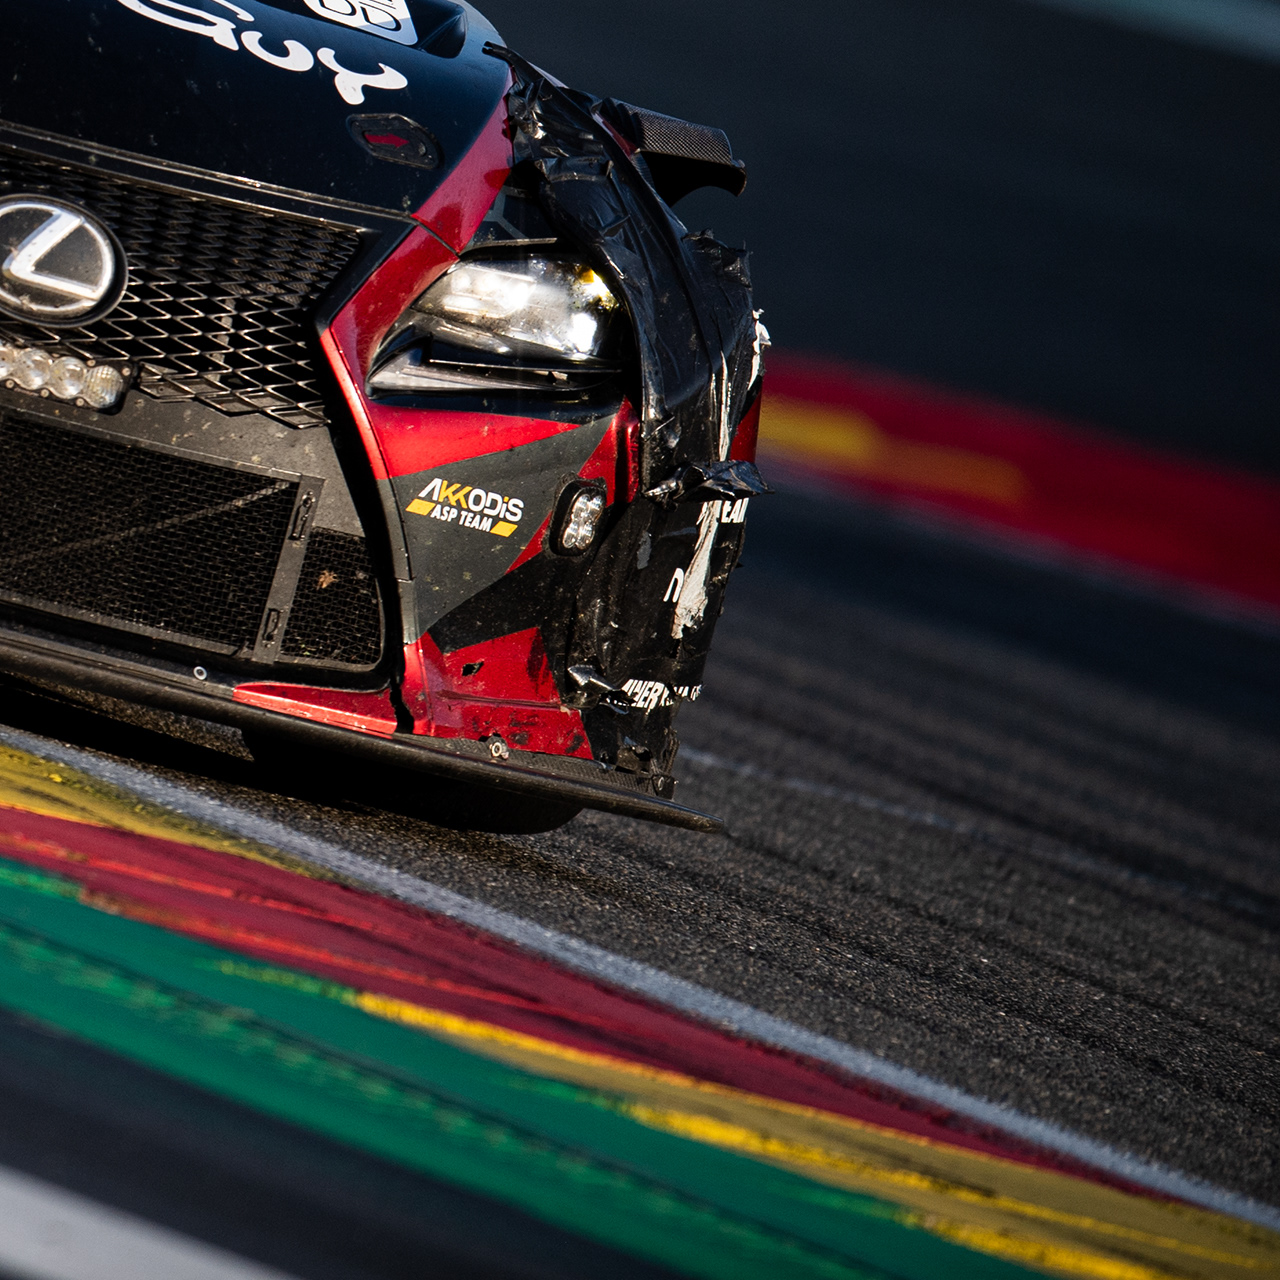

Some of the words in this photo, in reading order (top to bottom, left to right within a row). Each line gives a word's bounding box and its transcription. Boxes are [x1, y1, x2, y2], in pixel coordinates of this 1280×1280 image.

[418, 477, 525, 522] AKKODIS
[430, 503, 459, 522] ASP
[458, 510, 494, 533] TEAM
